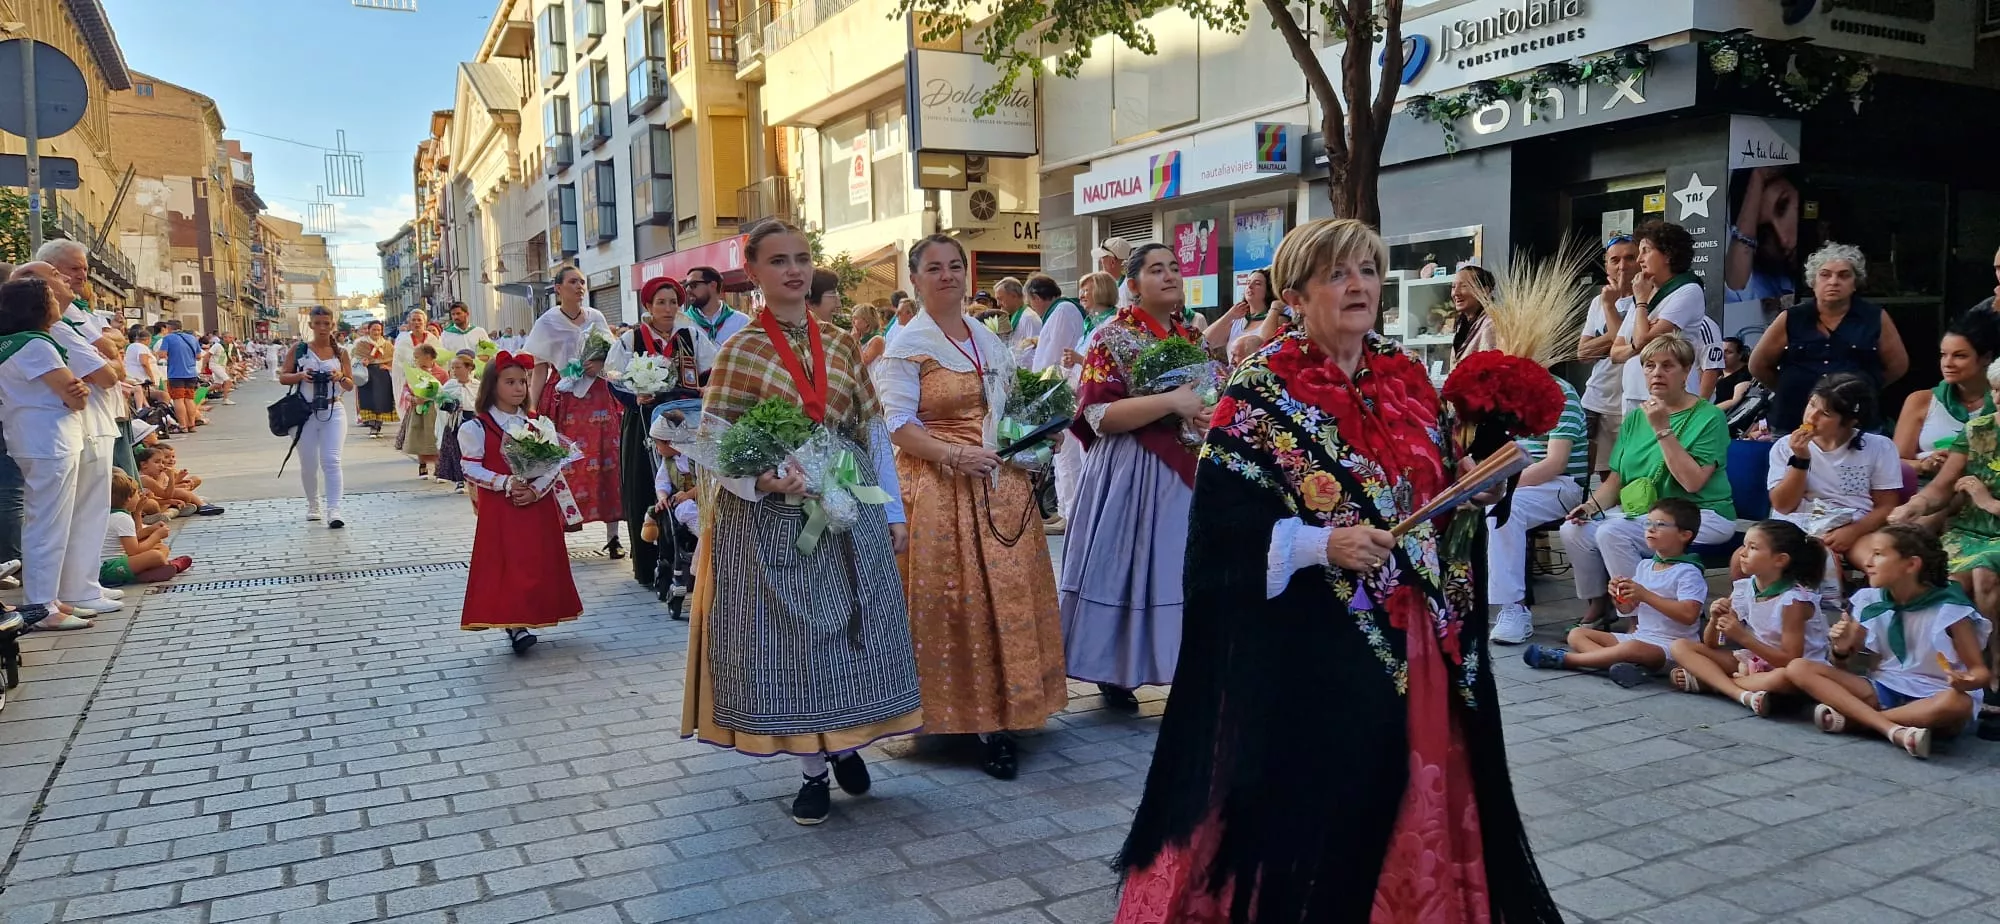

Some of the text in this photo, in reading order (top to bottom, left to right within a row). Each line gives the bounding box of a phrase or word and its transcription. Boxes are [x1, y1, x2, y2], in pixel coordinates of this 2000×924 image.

[1457, 27, 1586, 70] CONSTRUCCIONES
[1201, 160, 1253, 179] nautaliaviajes
[1257, 163, 1287, 171] NAUTALIA
[1082, 175, 1143, 205] NAUTALIA
